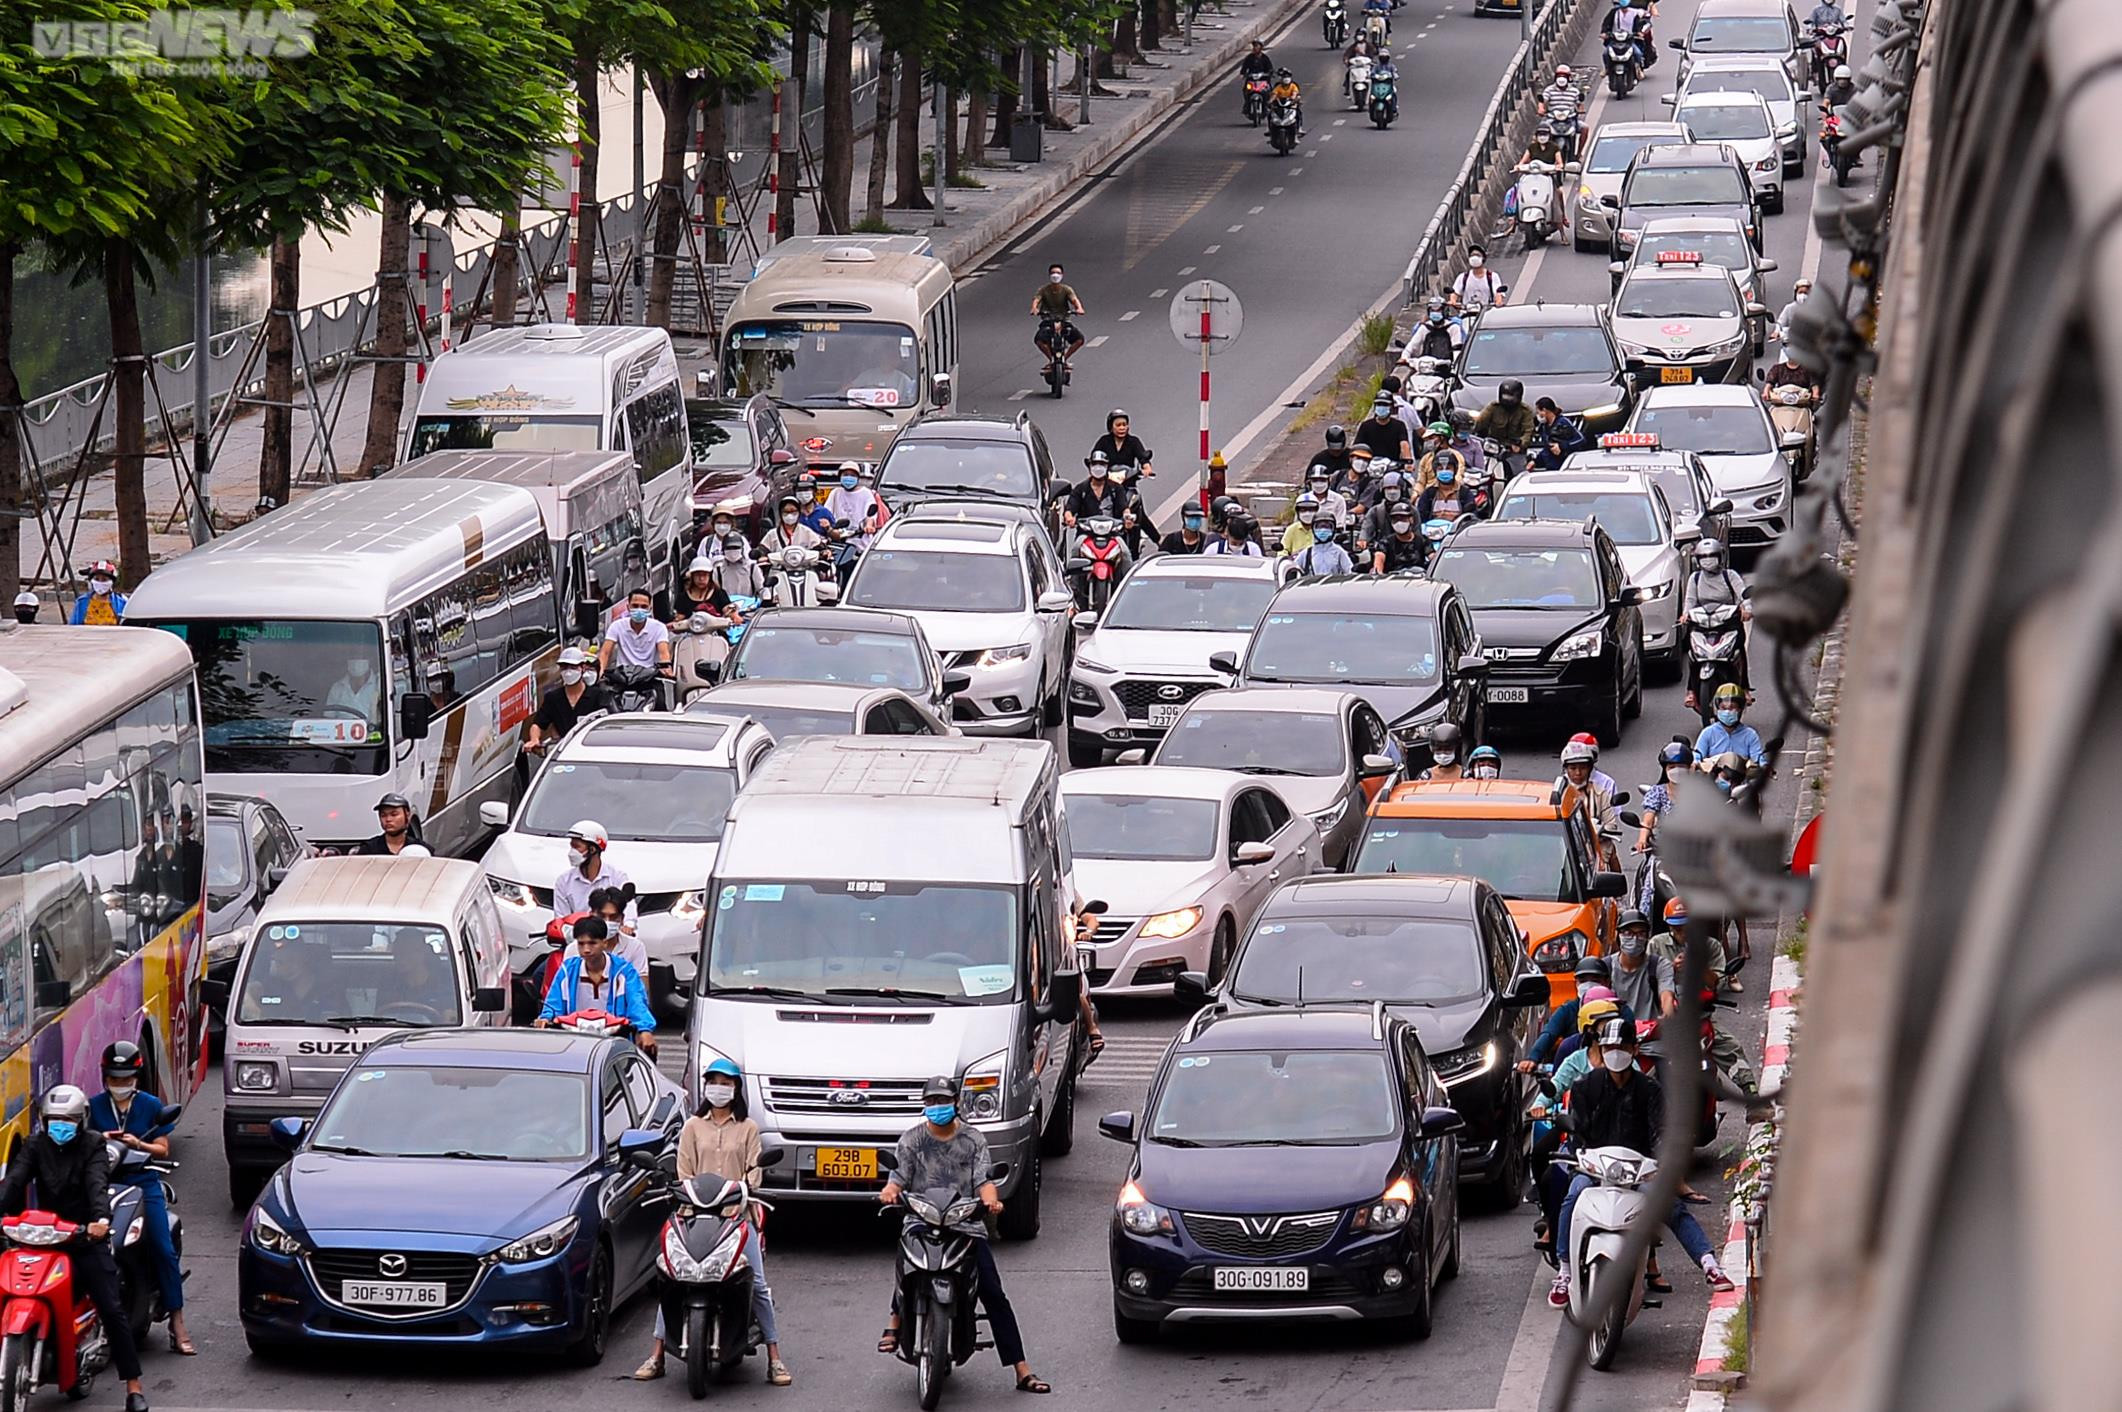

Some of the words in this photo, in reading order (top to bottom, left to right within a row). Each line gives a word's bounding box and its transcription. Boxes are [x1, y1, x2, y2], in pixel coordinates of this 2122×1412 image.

[1659, 251, 1677, 260] Taxi
[1680, 251, 1699, 260] 123
[874, 392, 897, 403] 20
[1608, 435, 1628, 444] Taxi
[1632, 434, 1655, 443] 123
[1160, 707, 1179, 716] 30G
[335, 723, 365, 740] 10
[834, 1150, 860, 1162] 29B
[823, 1163, 870, 1177] 603.07
[1217, 1271, 1306, 1288] 30G-091.89
[351, 1286, 437, 1302] 30F-977.86
